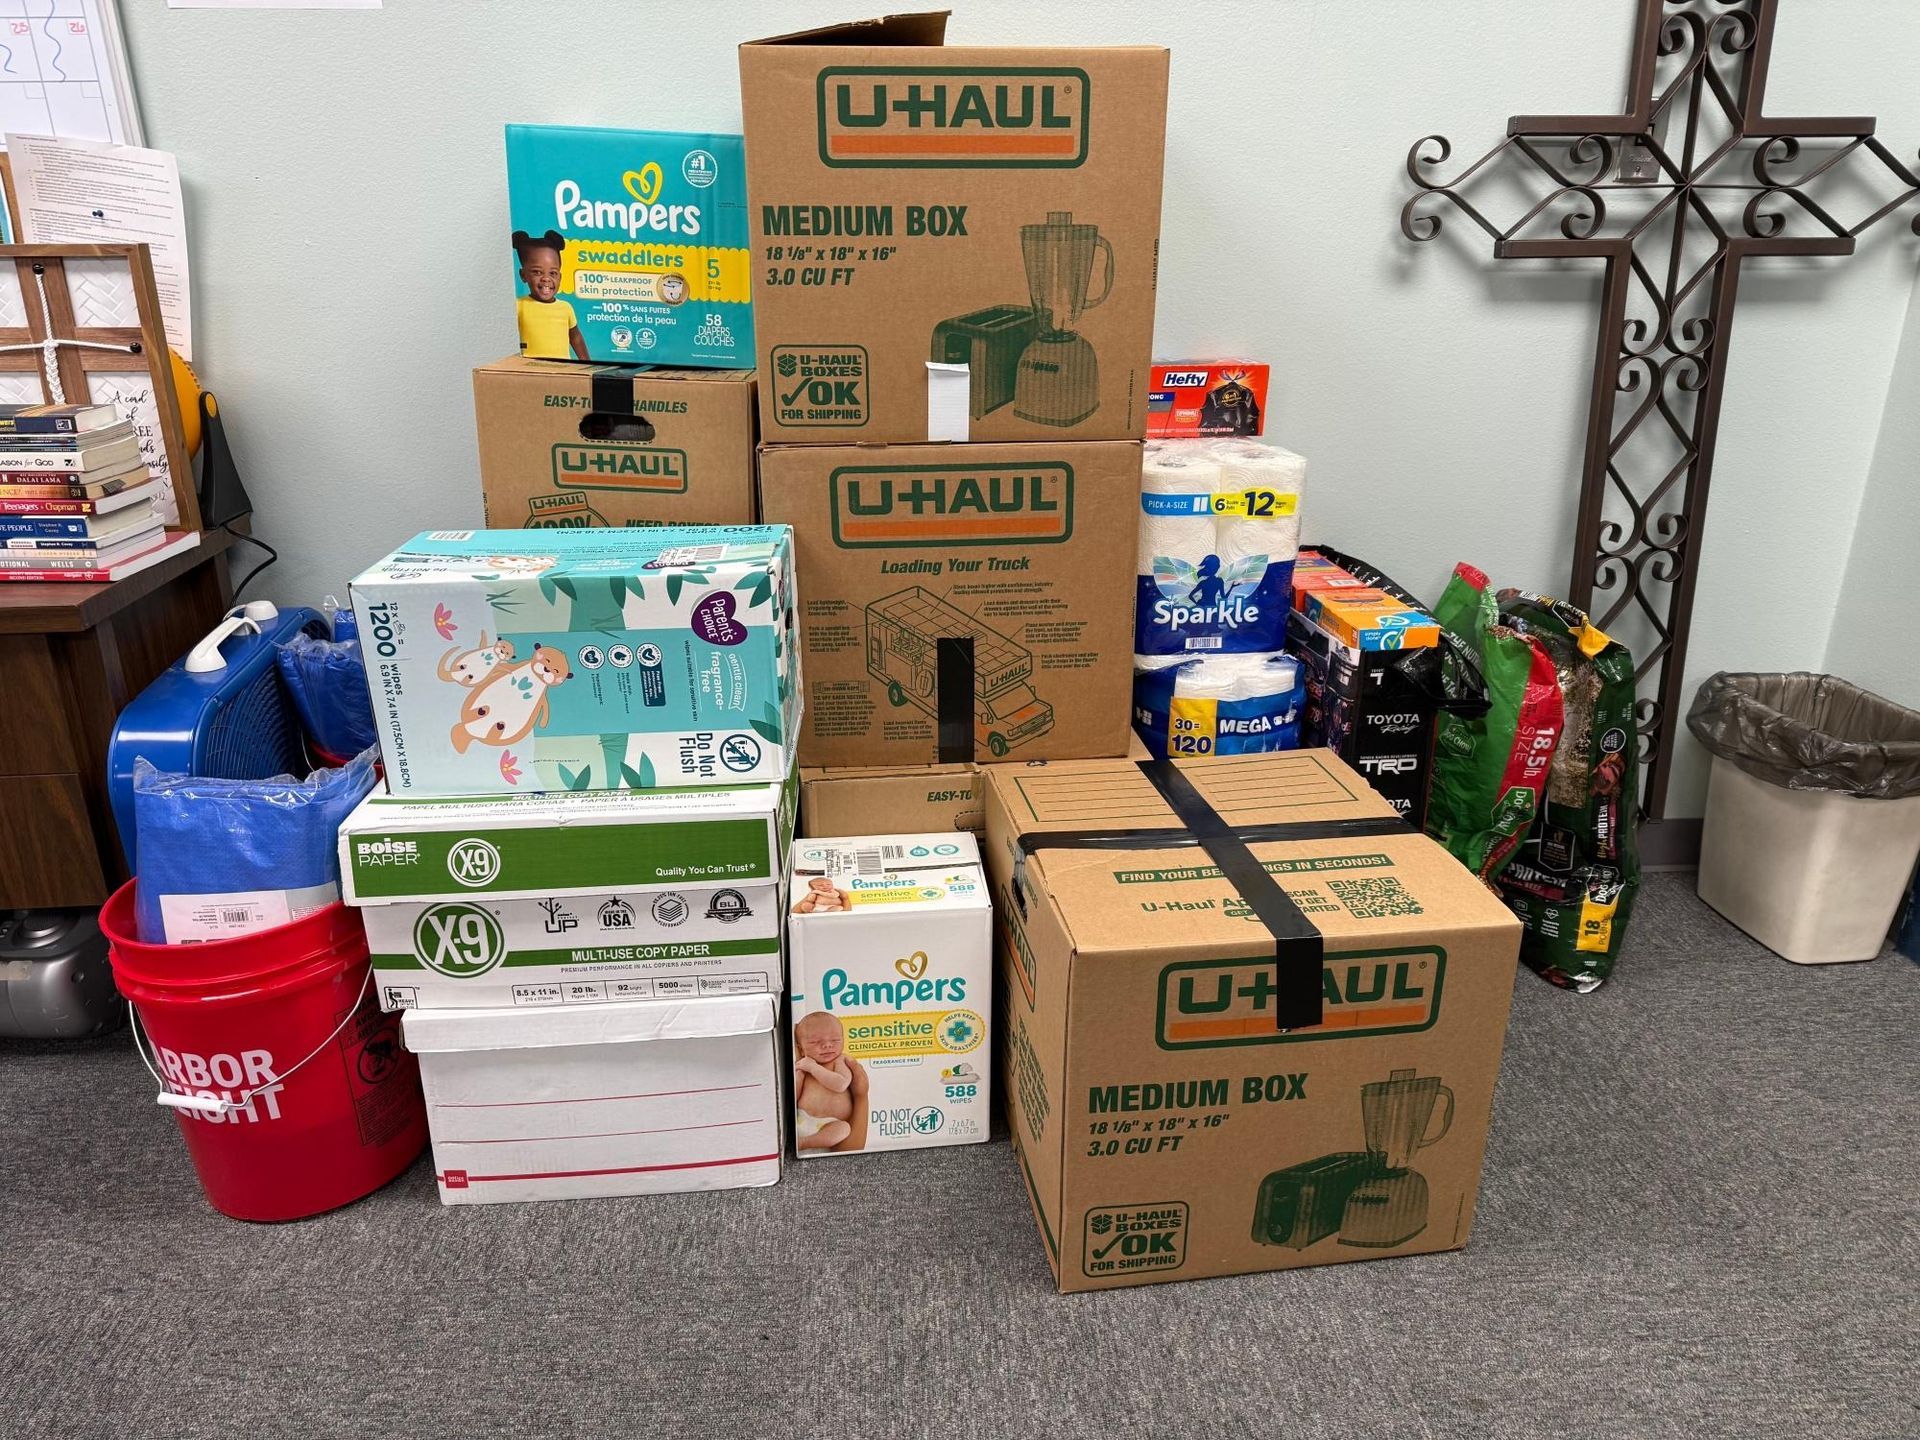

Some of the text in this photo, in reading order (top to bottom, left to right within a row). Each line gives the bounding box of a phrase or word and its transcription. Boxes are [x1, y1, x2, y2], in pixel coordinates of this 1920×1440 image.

[836, 84, 1072, 129] U-HAUL
[554, 180, 701, 239] Pampers
[762, 206, 969, 237] MEDIUM BOX
[577, 249, 684, 268] swaddlers
[766, 247, 783, 261] 18
[815, 252, 824, 261] x
[829, 247, 855, 261] 18"
[857, 252, 867, 261] x
[870, 246, 897, 261] 16"
[707, 258, 720, 278] 5
[610, 277, 652, 285] LEAKPROOF
[766, 268, 855, 286] 3.0 CU FT
[579, 286, 653, 300] skin protection
[630, 306, 647, 314] SANS
[587, 314, 677, 327] protection de peau
[705, 313, 722, 326] 58
[698, 325, 730, 336] DIAPERS
[693, 335, 735, 347] COUCHES
[800, 355, 862, 365] U-HAUL
[801, 367, 862, 376] BOXES
[1164, 372, 1208, 387] Hefty
[124, 389, 148, 403] cord
[808, 381, 860, 405] OK
[781, 409, 862, 419] FOR SHIPPING
[133, 425, 153, 437] REE
[561, 451, 679, 476] U-HAUL
[532, 494, 585, 510] U-HAUL
[848, 476, 1059, 515] U-HAUL
[3, 502, 76, 512] Teenagers Chapman
[1148, 499, 1188, 509] PICK-A-SIZE
[1214, 498, 1225, 511] 6
[1244, 491, 1276, 516] 12
[8, 524, 34, 532] PEOPLE
[880, 556, 1030, 576] Loading Your Truck
[390, 602, 398, 610] 12
[1153, 599, 1260, 631] Sparkle
[368, 602, 397, 657] 1200
[700, 608, 719, 639] CHOICE
[380, 664, 390, 677] 6.9
[990, 662, 1029, 689] U-HAUL
[382, 679, 393, 687] IN
[391, 663, 402, 695] wipes
[700, 670, 711, 693] free
[711, 651, 724, 710] fragrance-
[386, 697, 395, 708] 7.4
[734, 682, 743, 708] clean
[389, 710, 398, 719] IN
[1366, 713, 1420, 725] TOYOTA
[1219, 716, 1272, 734] MEGA
[1172, 734, 1212, 754] 120
[1514, 725, 1535, 761] SIZE
[679, 738, 698, 773] Flush
[696, 733, 717, 777] Do Not
[1359, 758, 1418, 775] TRD
[1388, 798, 1412, 809] OTA
[359, 853, 416, 867] PAPER
[459, 847, 490, 877] X-9
[655, 862, 749, 878] Quality You Can Trust
[1121, 855, 1387, 882] FIND YOUR IN SECONDS!
[851, 878, 916, 889] Pampers
[949, 884, 975, 892] 588
[1141, 898, 1215, 913] U-Haul
[1306, 897, 1329, 905] GET
[545, 918, 577, 933] UP
[603, 913, 631, 927] USA
[1584, 919, 1601, 937] 18
[433, 913, 490, 967] X-9
[572, 945, 710, 962] MULTI-USE COPY PAPER
[589, 964, 633, 972] PERFORMANCE
[658, 981, 679, 989] 5000
[822, 968, 967, 1010] Pampers
[848, 1019, 933, 1039] sensitive
[848, 1038, 934, 1051] CLINICALLY PROVEN
[154, 1048, 276, 1088] ARBOR
[872, 1058, 906, 1066] FRAGRANCE
[945, 1085, 977, 1098] 588
[1088, 1073, 1308, 1114] MEDIUM BOX
[871, 1108, 912, 1123] DO NOT
[879, 1122, 911, 1136] FLUSH
[1088, 1119, 1107, 1134] 18
[1142, 1122, 1154, 1132] x
[1155, 1116, 1184, 1131] 18"
[1187, 1119, 1198, 1129] x
[1202, 1113, 1230, 1127] 16"
[1087, 1136, 1184, 1157] 3.0 CU FT
[1116, 1208, 1182, 1221] U-HAUL
[1115, 1218, 1182, 1232] BOXES
[1124, 1231, 1177, 1256] OK
[1090, 1256, 1176, 1272] FOR SHIPPING
